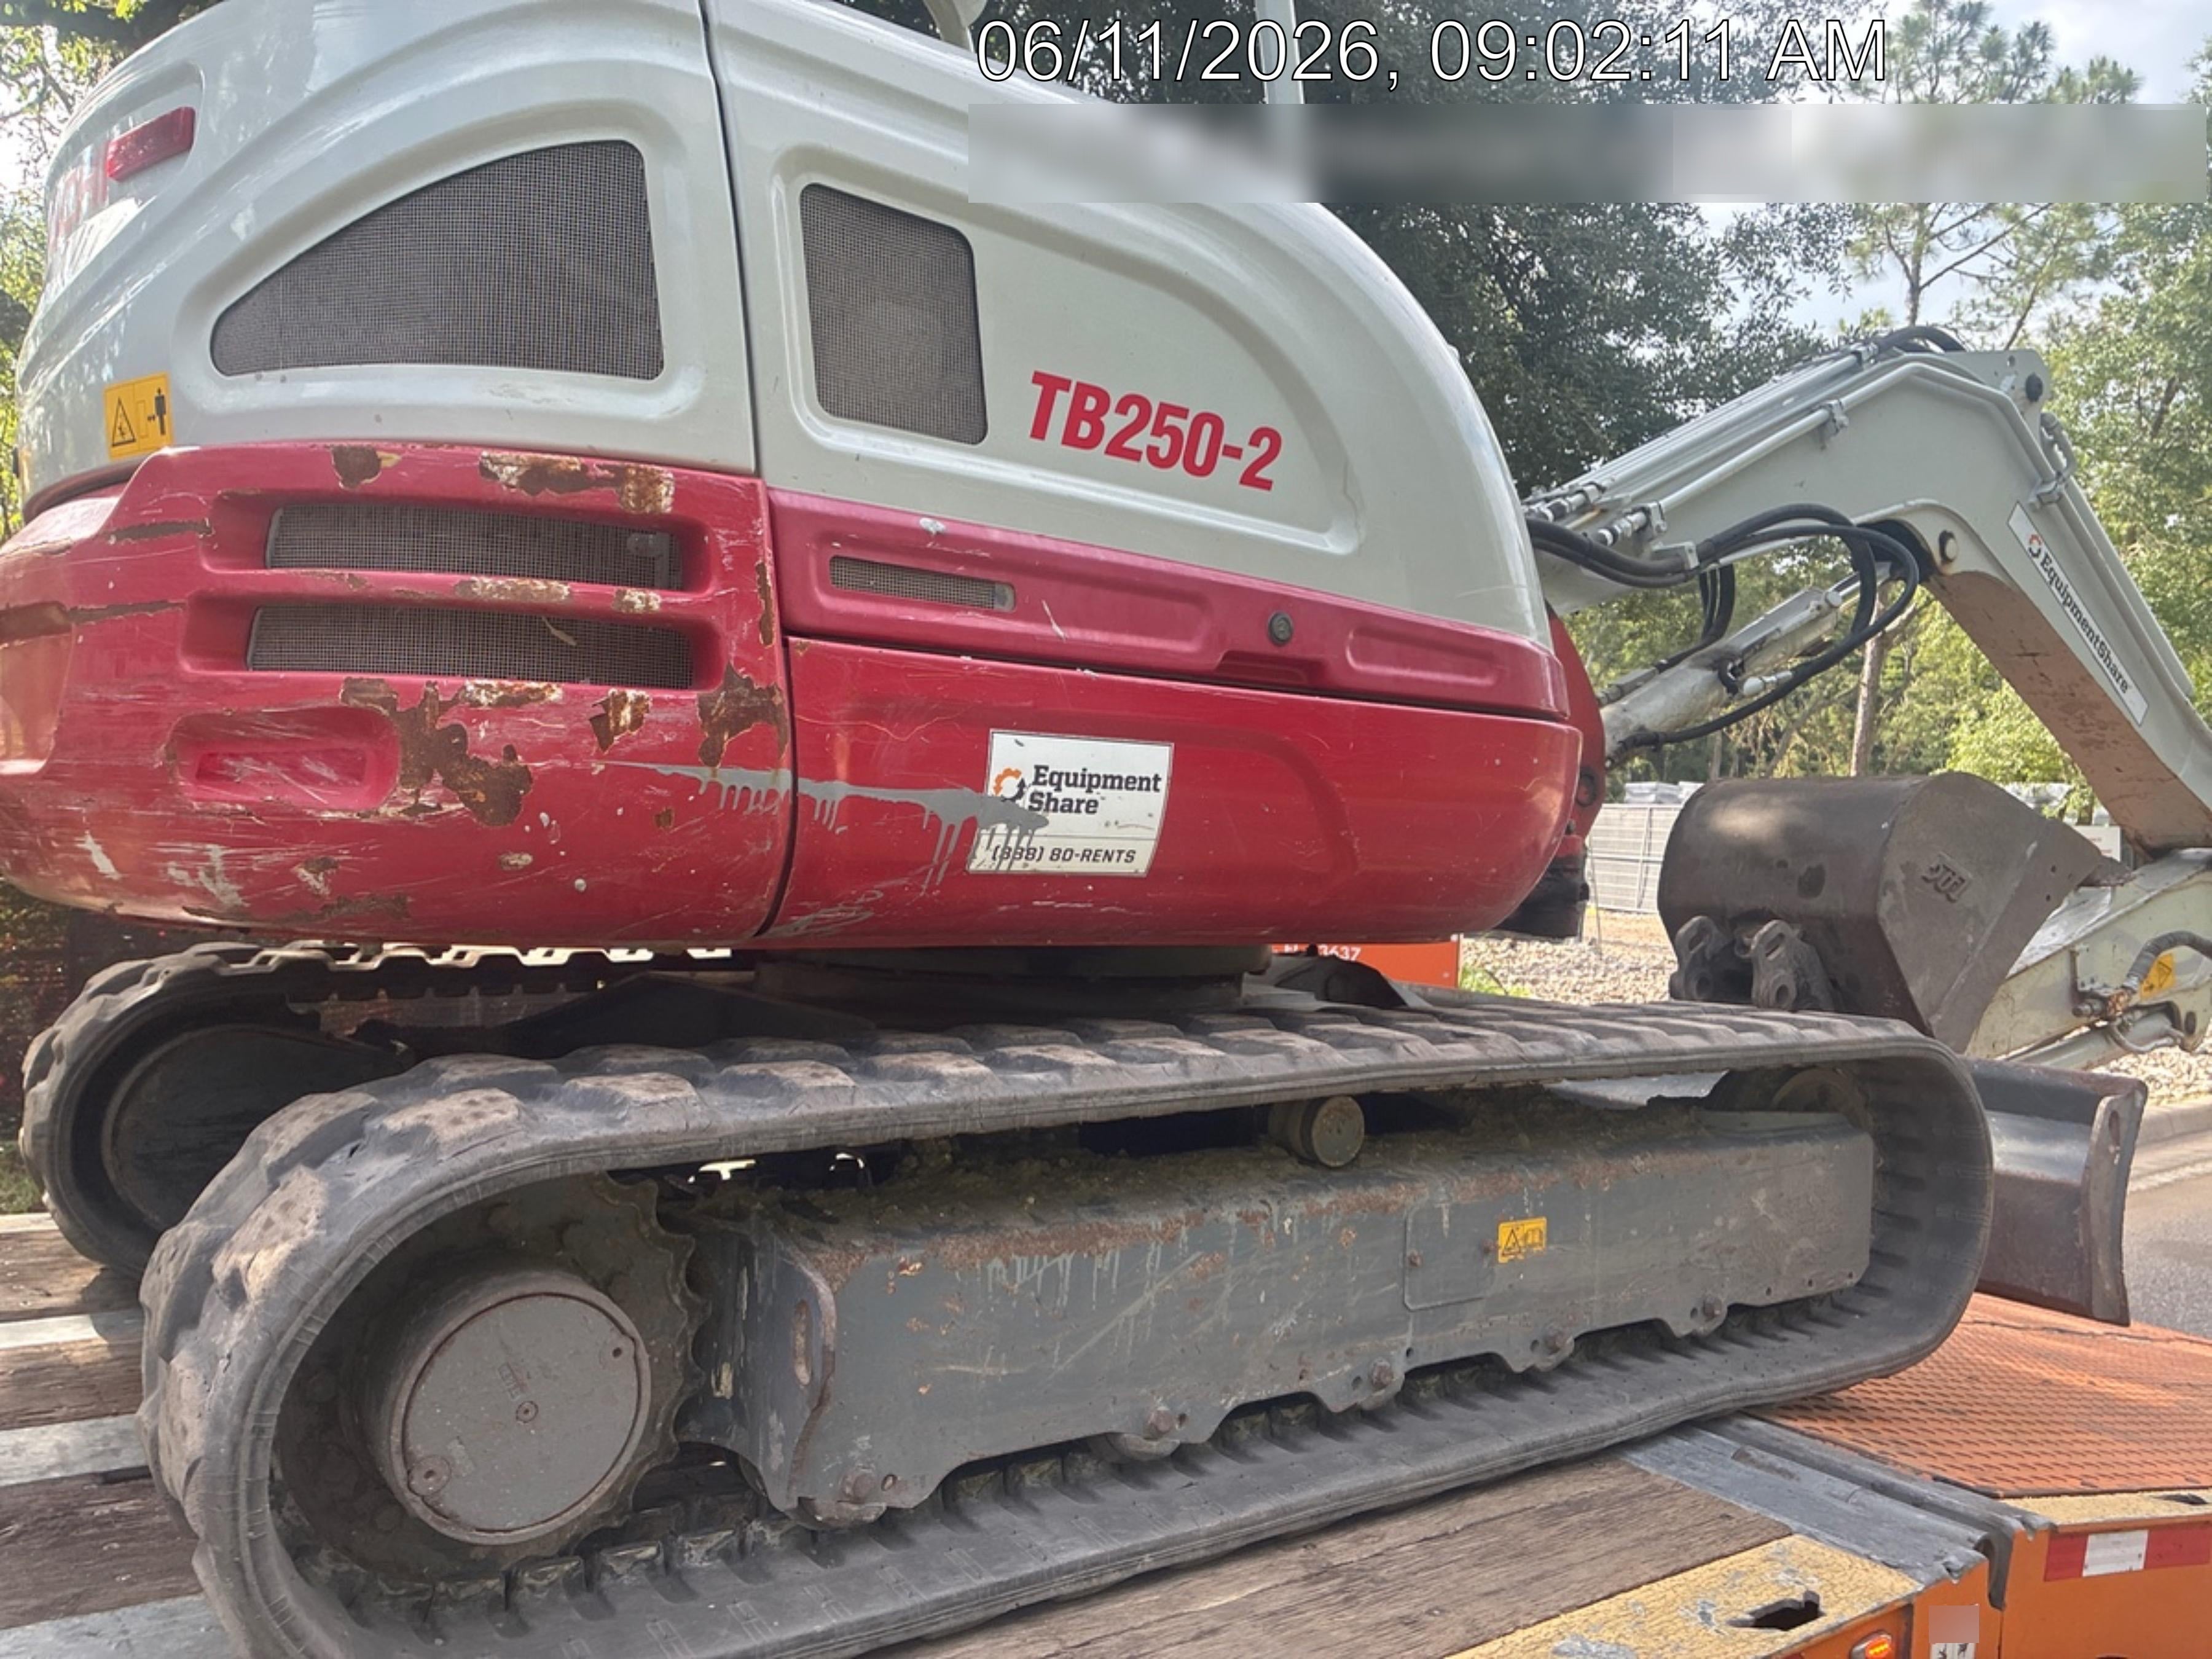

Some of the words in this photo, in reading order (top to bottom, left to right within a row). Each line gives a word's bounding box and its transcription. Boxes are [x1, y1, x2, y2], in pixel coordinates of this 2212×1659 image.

[1029, 370, 1282, 492] TB250-2
[2039, 554, 2129, 694] EquipmentShare
[1032, 764, 1161, 794] Equipment
[1029, 791, 1099, 815] Share
[1049, 847, 1136, 864] 80-RENTS
